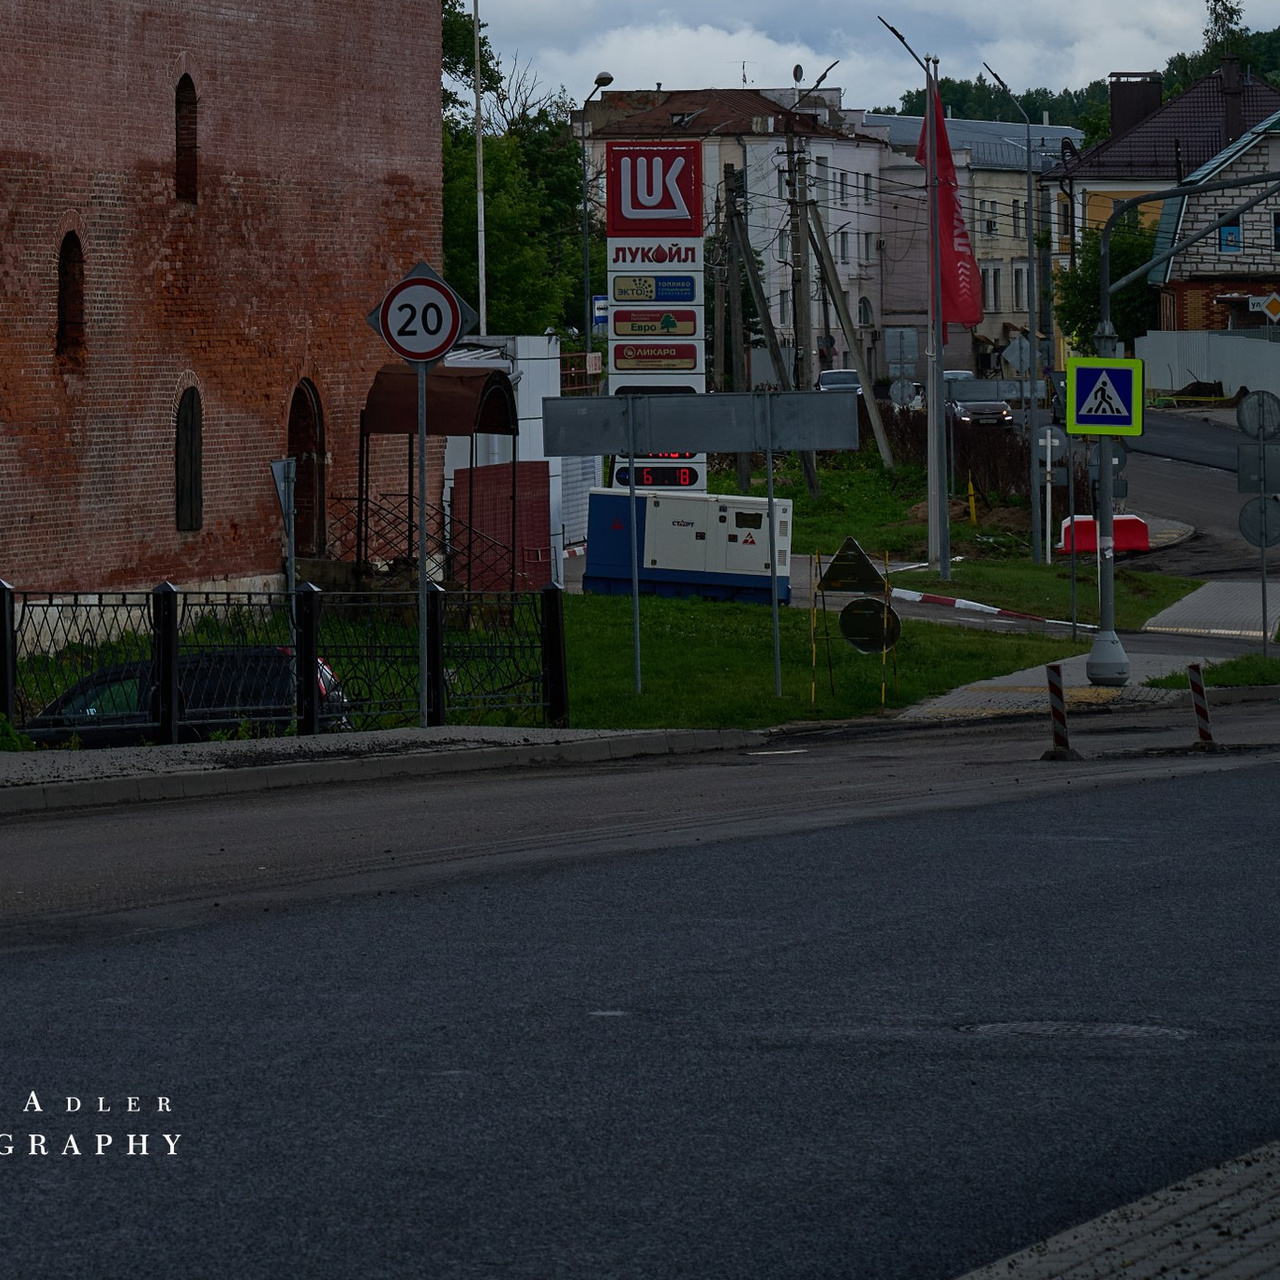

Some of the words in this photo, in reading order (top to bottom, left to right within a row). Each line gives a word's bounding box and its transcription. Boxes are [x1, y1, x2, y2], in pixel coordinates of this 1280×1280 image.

[612, 243, 696, 264] ЛУКОЙЛ
[617, 288, 643, 296] ЭКТО
[397, 302, 443, 337] 20
[630, 322, 657, 333] Евро
